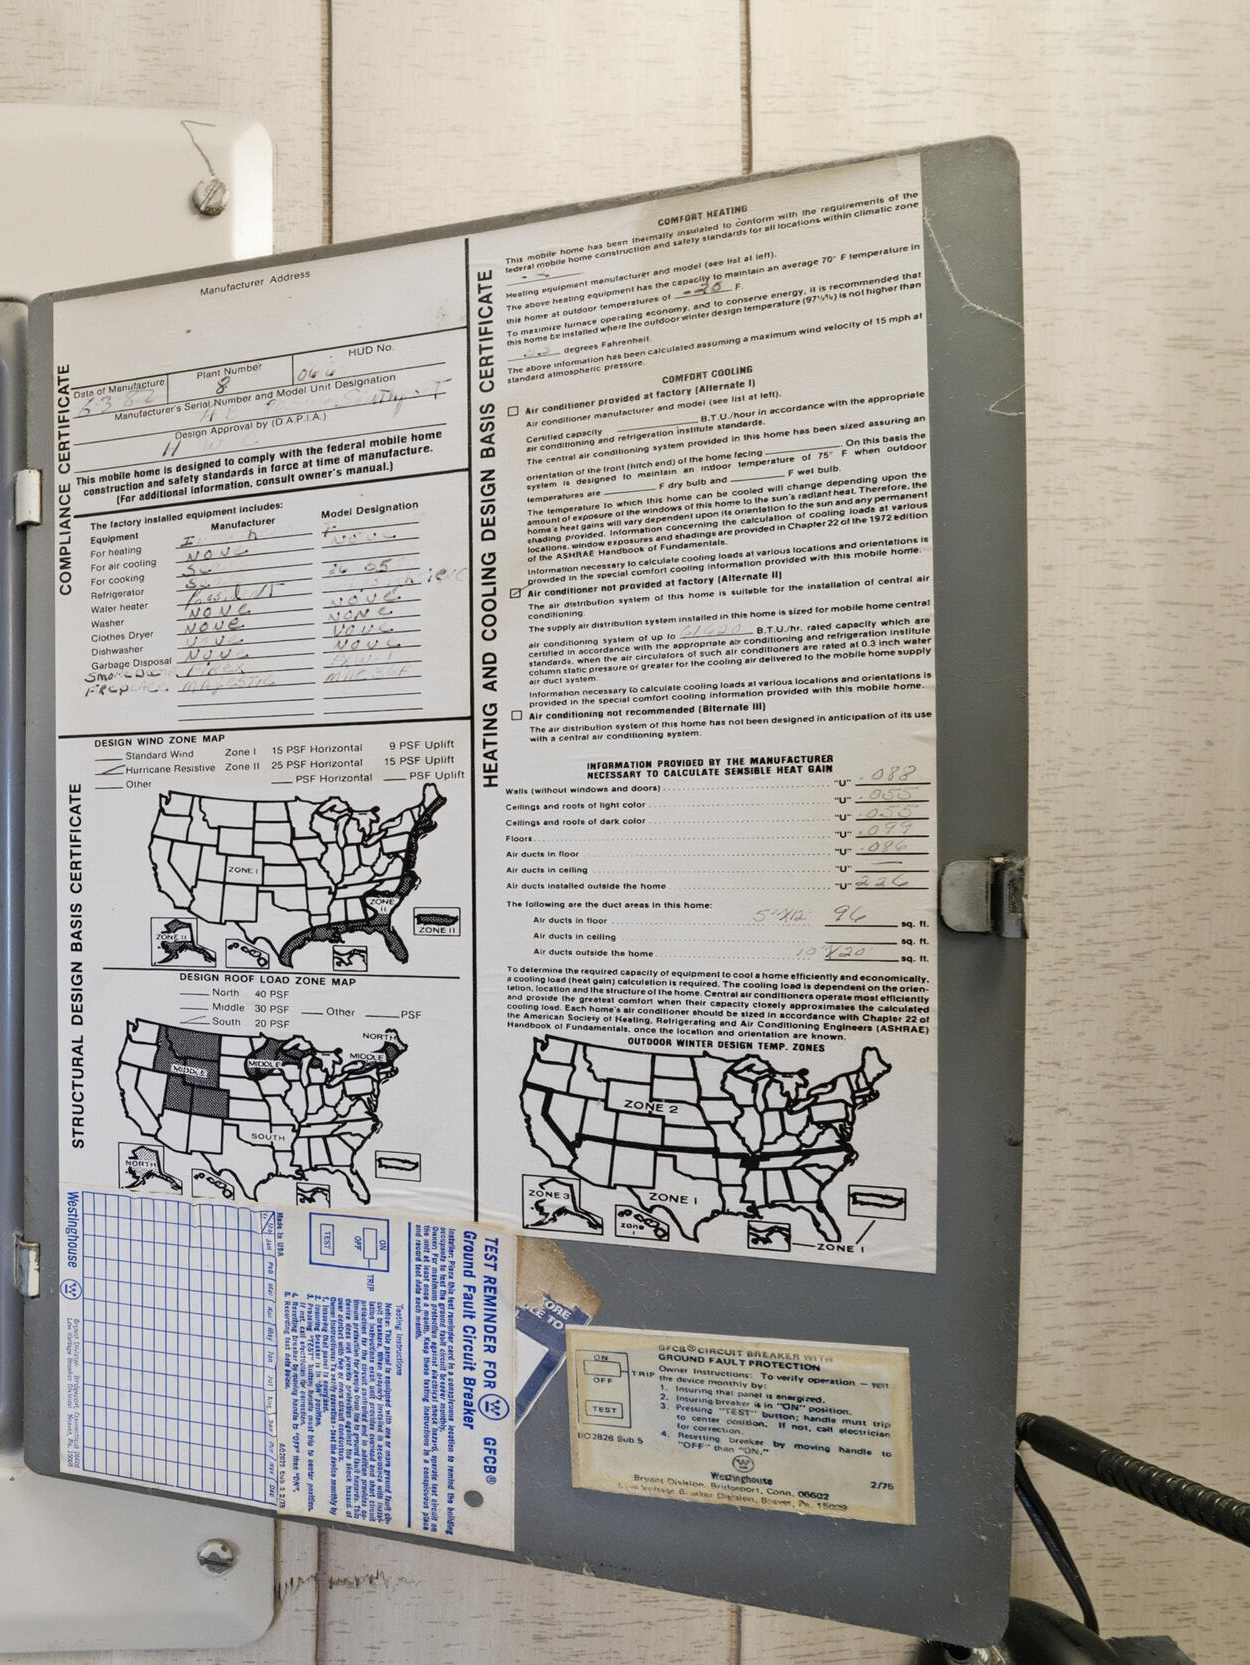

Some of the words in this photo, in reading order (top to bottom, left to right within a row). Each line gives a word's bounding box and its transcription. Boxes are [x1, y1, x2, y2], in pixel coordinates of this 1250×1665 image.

[657, 210, 703, 226] COMFORT
[708, 205, 748, 219] HEATING
[200, 278, 264, 296] Manufacturer
[270, 270, 310, 285] Address
[478, 268, 495, 394] CERTIFICATE
[197, 369, 221, 379] Plant
[224, 363, 262, 376] Number
[662, 370, 708, 384] COMFORT
[712, 364, 753, 379] COOLING
[525, 405, 542, 415] Air
[545, 399, 595, 413] conditioner
[598, 394, 640, 408] provided
[644, 393, 654, 401] at
[656, 386, 692, 400] factory
[58, 363, 71, 475] CERTIFICATE
[478, 402, 495, 460] BASIS
[77, 476, 95, 486] This
[98, 471, 130, 485] mobile
[134, 469, 160, 479] home
[164, 466, 172, 475] is
[175, 461, 222, 475] designed
[224, 459, 236, 469] to
[238, 453, 276, 468] comply
[279, 449, 303, 461] with
[306, 446, 323, 457] the
[326, 440, 366, 455] federal
[369, 435, 407, 449] mobile
[411, 430, 442, 443] home
[480, 467, 496, 543] DESIGN
[59, 481, 72, 596] COMPLIANCE
[91, 532, 139, 545] Equipment
[211, 517, 275, 531] Manufacturer
[91, 588, 144, 601] Refrigerator
[481, 550, 498, 641] COOLING
[91, 618, 125, 628] Washer
[91, 645, 143, 656] Dishwasher
[483, 650, 498, 691] AND
[95, 738, 134, 748] DESIGN
[137, 737, 163, 745] WIND
[168, 735, 198, 745] ZONE
[202, 734, 225, 743] MAP
[483, 701, 498, 788] HEATING
[126, 765, 169, 774] Hurricane
[172, 763, 215, 773] Resistive
[225, 762, 249, 771] Zone
[254, 762, 260, 770] II
[272, 761, 283, 770] 25
[286, 761, 306, 770] PSF
[310, 759, 363, 768] Horizontal
[587, 760, 651, 770] INFORMATION
[658, 759, 704, 768] PROVIDED
[709, 758, 720, 767] BY
[726, 757, 744, 766] THE
[750, 755, 833, 765] MANUFACTURER
[69, 782, 82, 894] CERTIFICATE
[71, 901, 83, 951] BASIS
[72, 960, 84, 1025] DESIGN
[180, 973, 220, 982] DESIGN
[225, 974, 255, 983] ROOF
[260, 975, 291, 985] LOAD
[295, 977, 326, 986] ZONE
[331, 977, 356, 987] MAP
[212, 989, 239, 998] North
[255, 990, 266, 998] 40
[269, 990, 290, 999] PSF
[628, 1037, 673, 1047] OUTDOOR
[676, 1039, 713, 1049] WINTER
[718, 1040, 753, 1050] DESIGN
[759, 1042, 789, 1051] TEMP.
[793, 1043, 825, 1052] ZONES
[72, 1034, 85, 1149] STRUCTURAL
[624, 1100, 663, 1112] ZONE
[669, 1105, 678, 1113] 2
[251, 1133, 285, 1141] SOUTH
[66, 1192, 79, 1268] Westinghouse
[463, 1229, 477, 1278] Ground
[484, 1237, 499, 1270] TEST
[462, 1286, 477, 1320] Fault
[484, 1273, 498, 1354] REMINDER
[462, 1323, 477, 1371] Circuit
[484, 1362, 498, 1390] FOR
[658, 1353, 705, 1364] GROUND
[709, 1356, 745, 1366] FAULT
[749, 1360, 820, 1372] PROTECTION
[462, 1376, 475, 1431] Breaker
